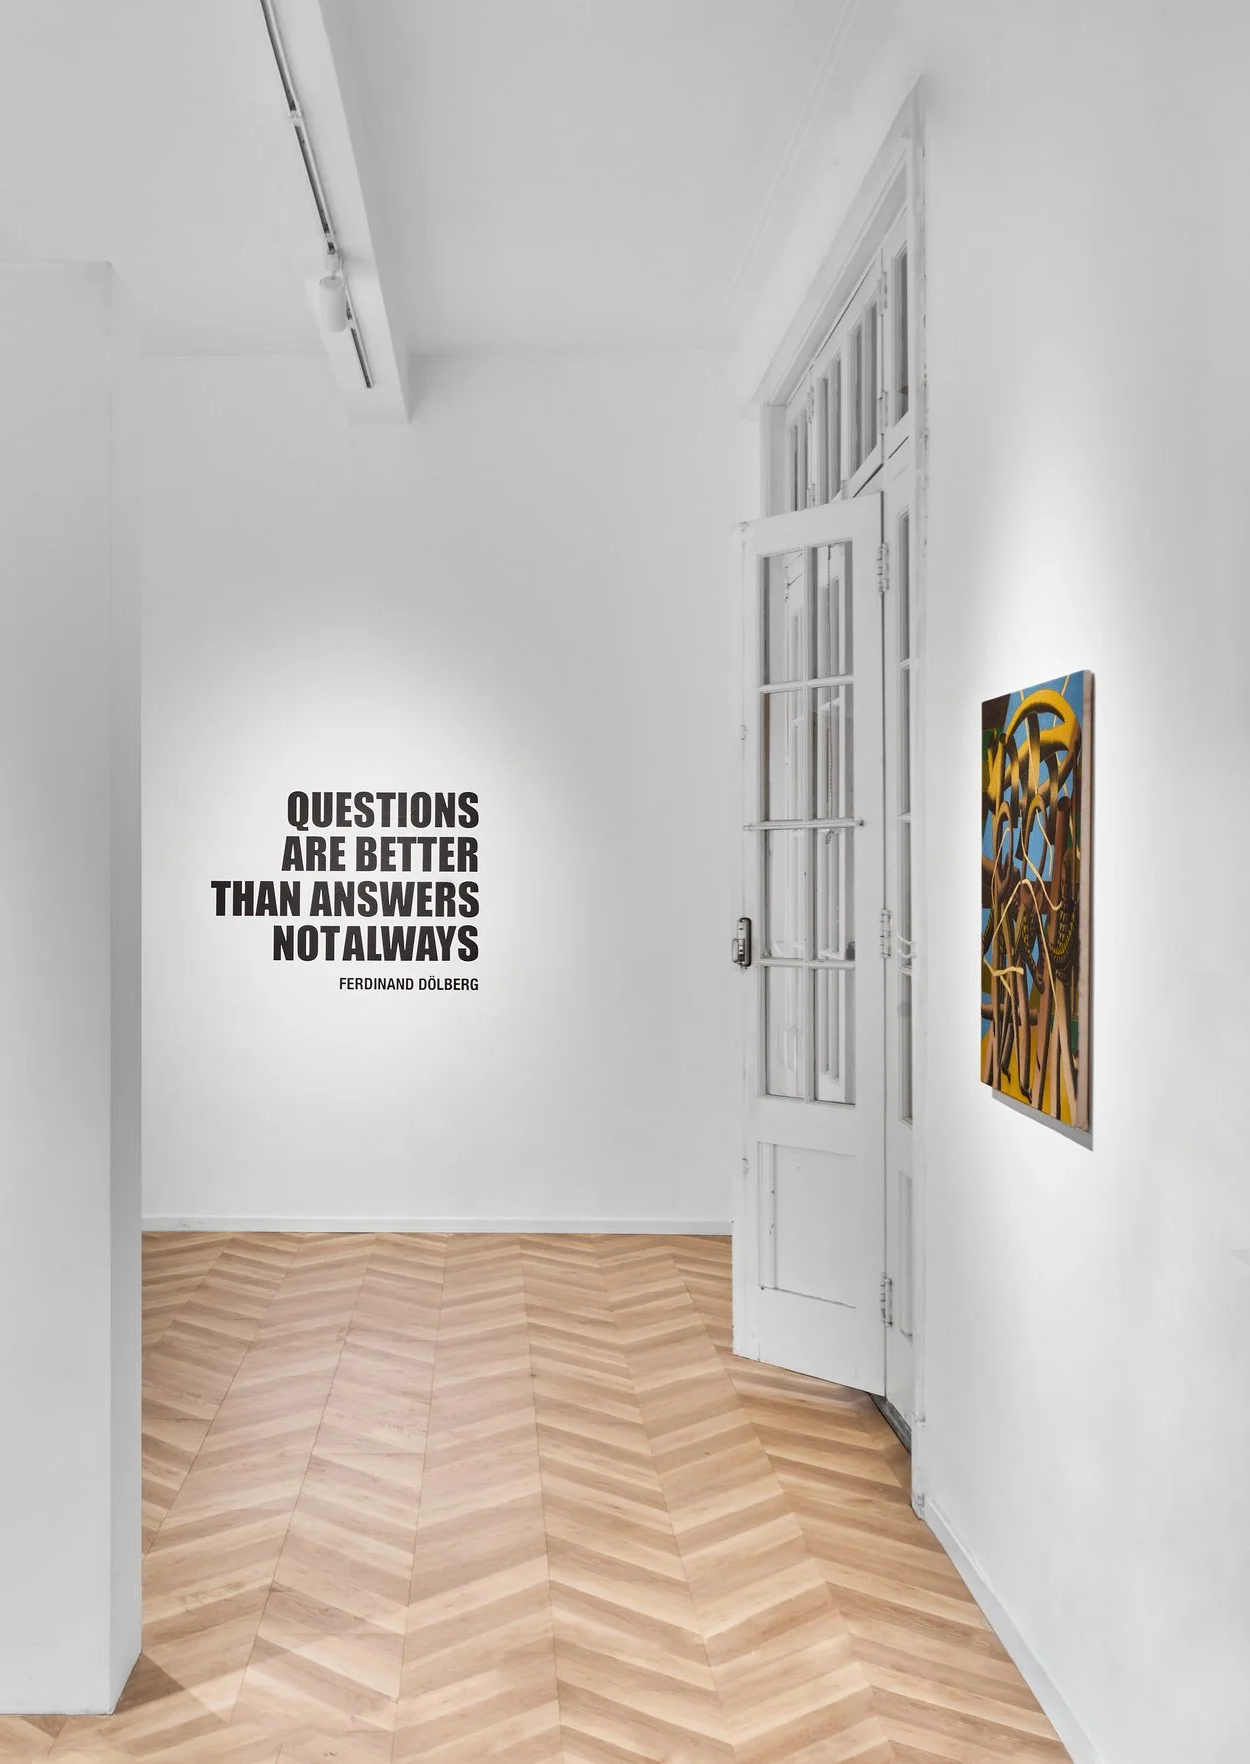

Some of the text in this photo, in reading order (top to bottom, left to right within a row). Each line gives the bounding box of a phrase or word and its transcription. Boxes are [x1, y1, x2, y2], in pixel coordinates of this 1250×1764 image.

[287, 790, 480, 832] QUESTIONS
[281, 835, 479, 873] ARE BETTER
[210, 880, 480, 918] THAN ANSWERS
[339, 975, 479, 991] FERDINAND DÖLBERG
